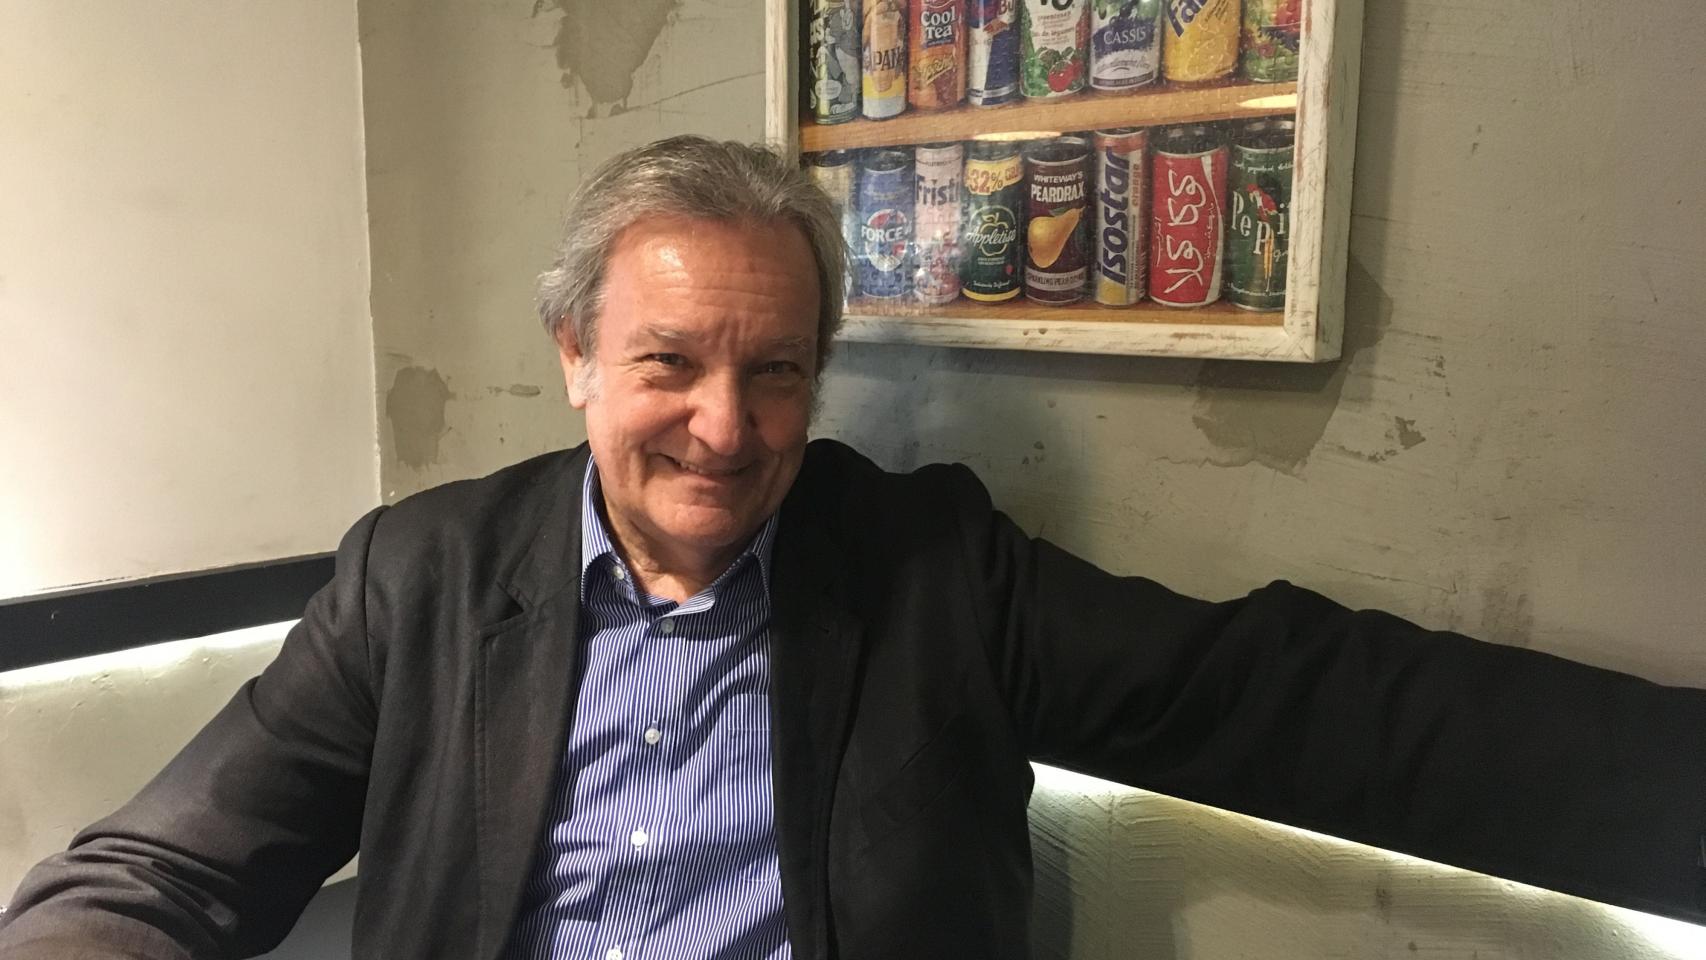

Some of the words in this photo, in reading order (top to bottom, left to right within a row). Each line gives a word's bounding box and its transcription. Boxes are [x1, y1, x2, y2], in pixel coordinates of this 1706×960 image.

[921, 6, 956, 26] Cool
[926, 25, 952, 39] Tea
[1103, 26, 1146, 45] CASSIS
[970, 168, 1003, 192] 32%
[1033, 171, 1083, 184] WHITEWAY'S
[1031, 181, 1085, 203] PEARDRAX
[1167, 169, 1206, 227] كوكا
[1099, 146, 1130, 285] isostar
[861, 225, 903, 243] FORCE
[1163, 234, 1204, 294] كولا
